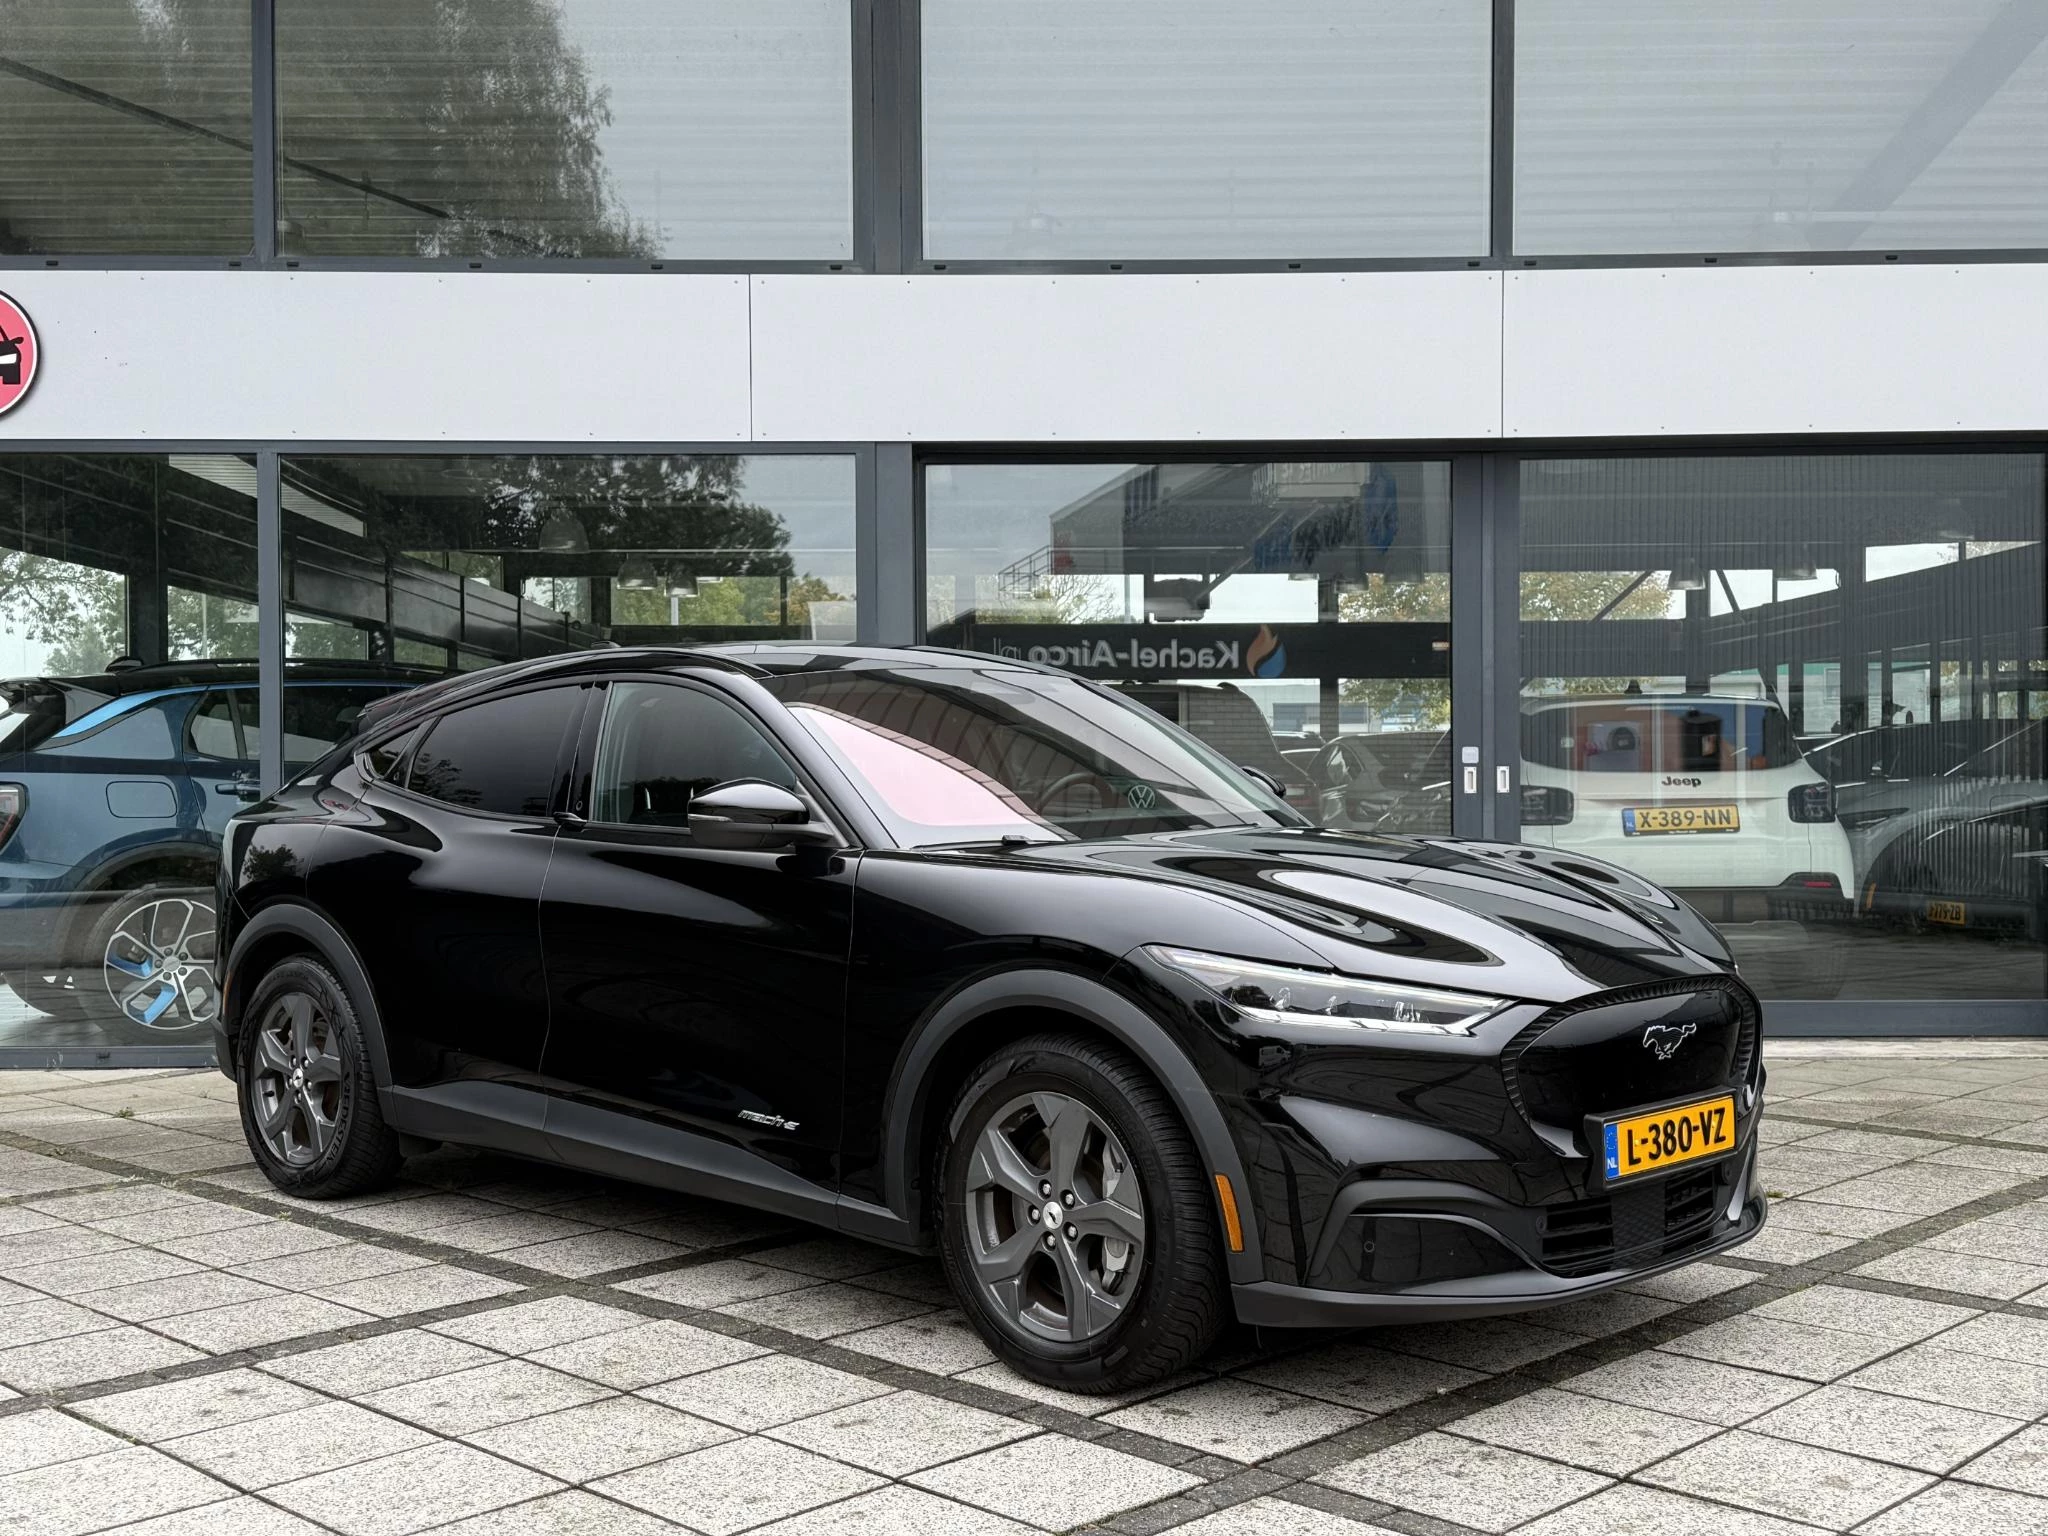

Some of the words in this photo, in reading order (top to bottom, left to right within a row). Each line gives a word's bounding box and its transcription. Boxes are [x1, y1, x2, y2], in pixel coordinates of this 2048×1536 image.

[1661, 776, 1702, 787] Jeep
[1640, 809, 1731, 829] X-389-NN
[1627, 1107, 1726, 1166] L-380-VZ
[1607, 1157, 1618, 1170] NL
